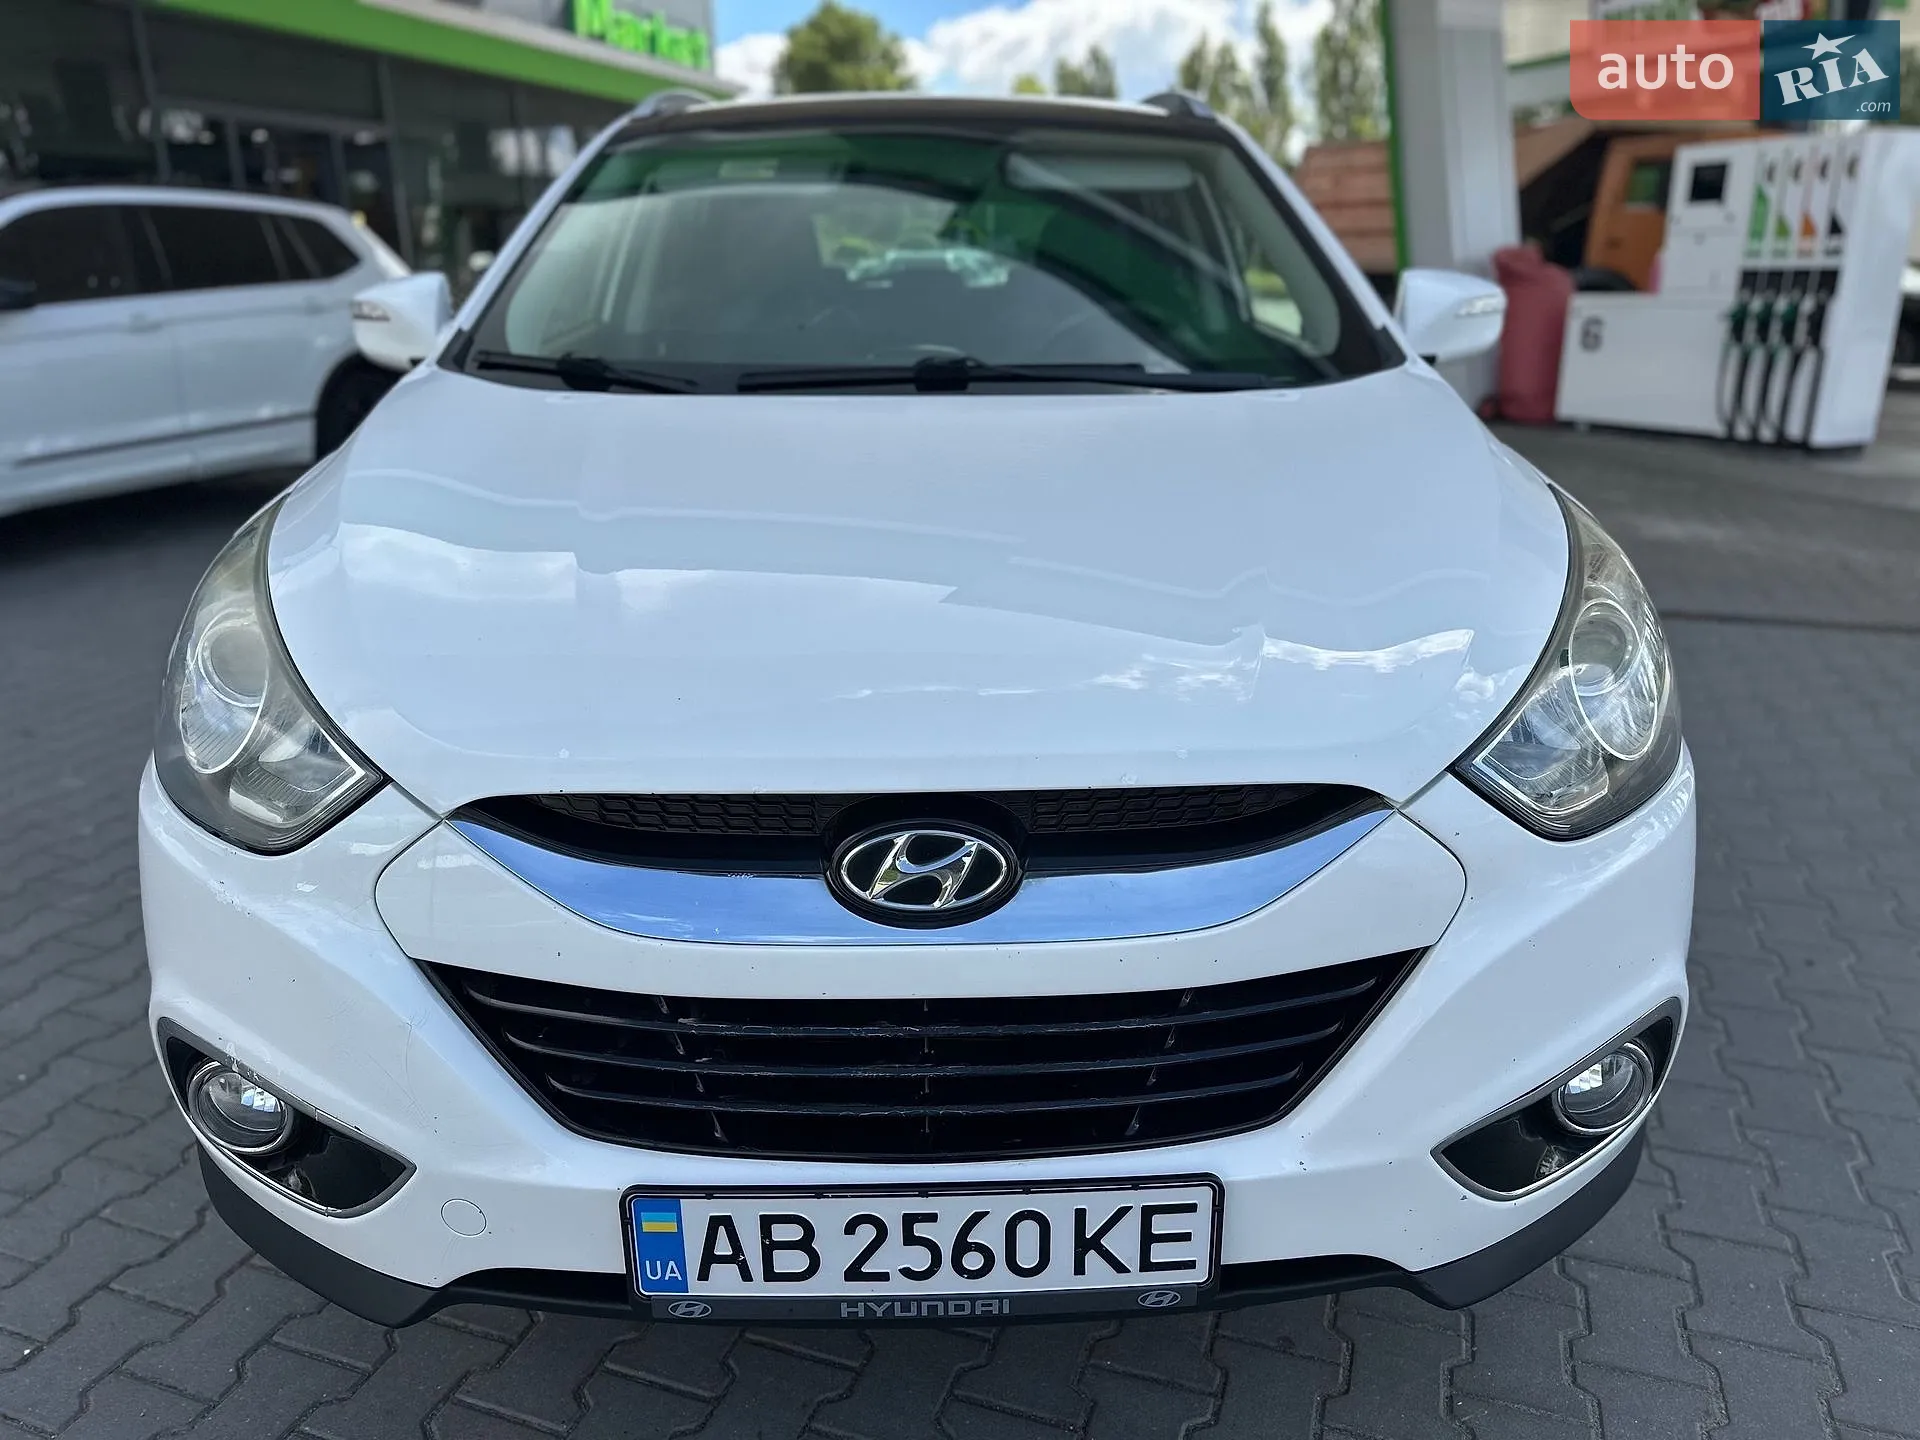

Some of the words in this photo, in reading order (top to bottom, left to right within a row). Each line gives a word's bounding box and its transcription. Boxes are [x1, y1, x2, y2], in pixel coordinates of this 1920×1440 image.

[573, 0, 711, 70] Market
[1580, 317, 1604, 351] 6
[696, 1213, 821, 1283] AB
[843, 1209, 1051, 1282] 2560
[1073, 1202, 1198, 1276] KE
[645, 1260, 682, 1281] UA
[840, 1298, 1010, 1318] HYUNDAI
